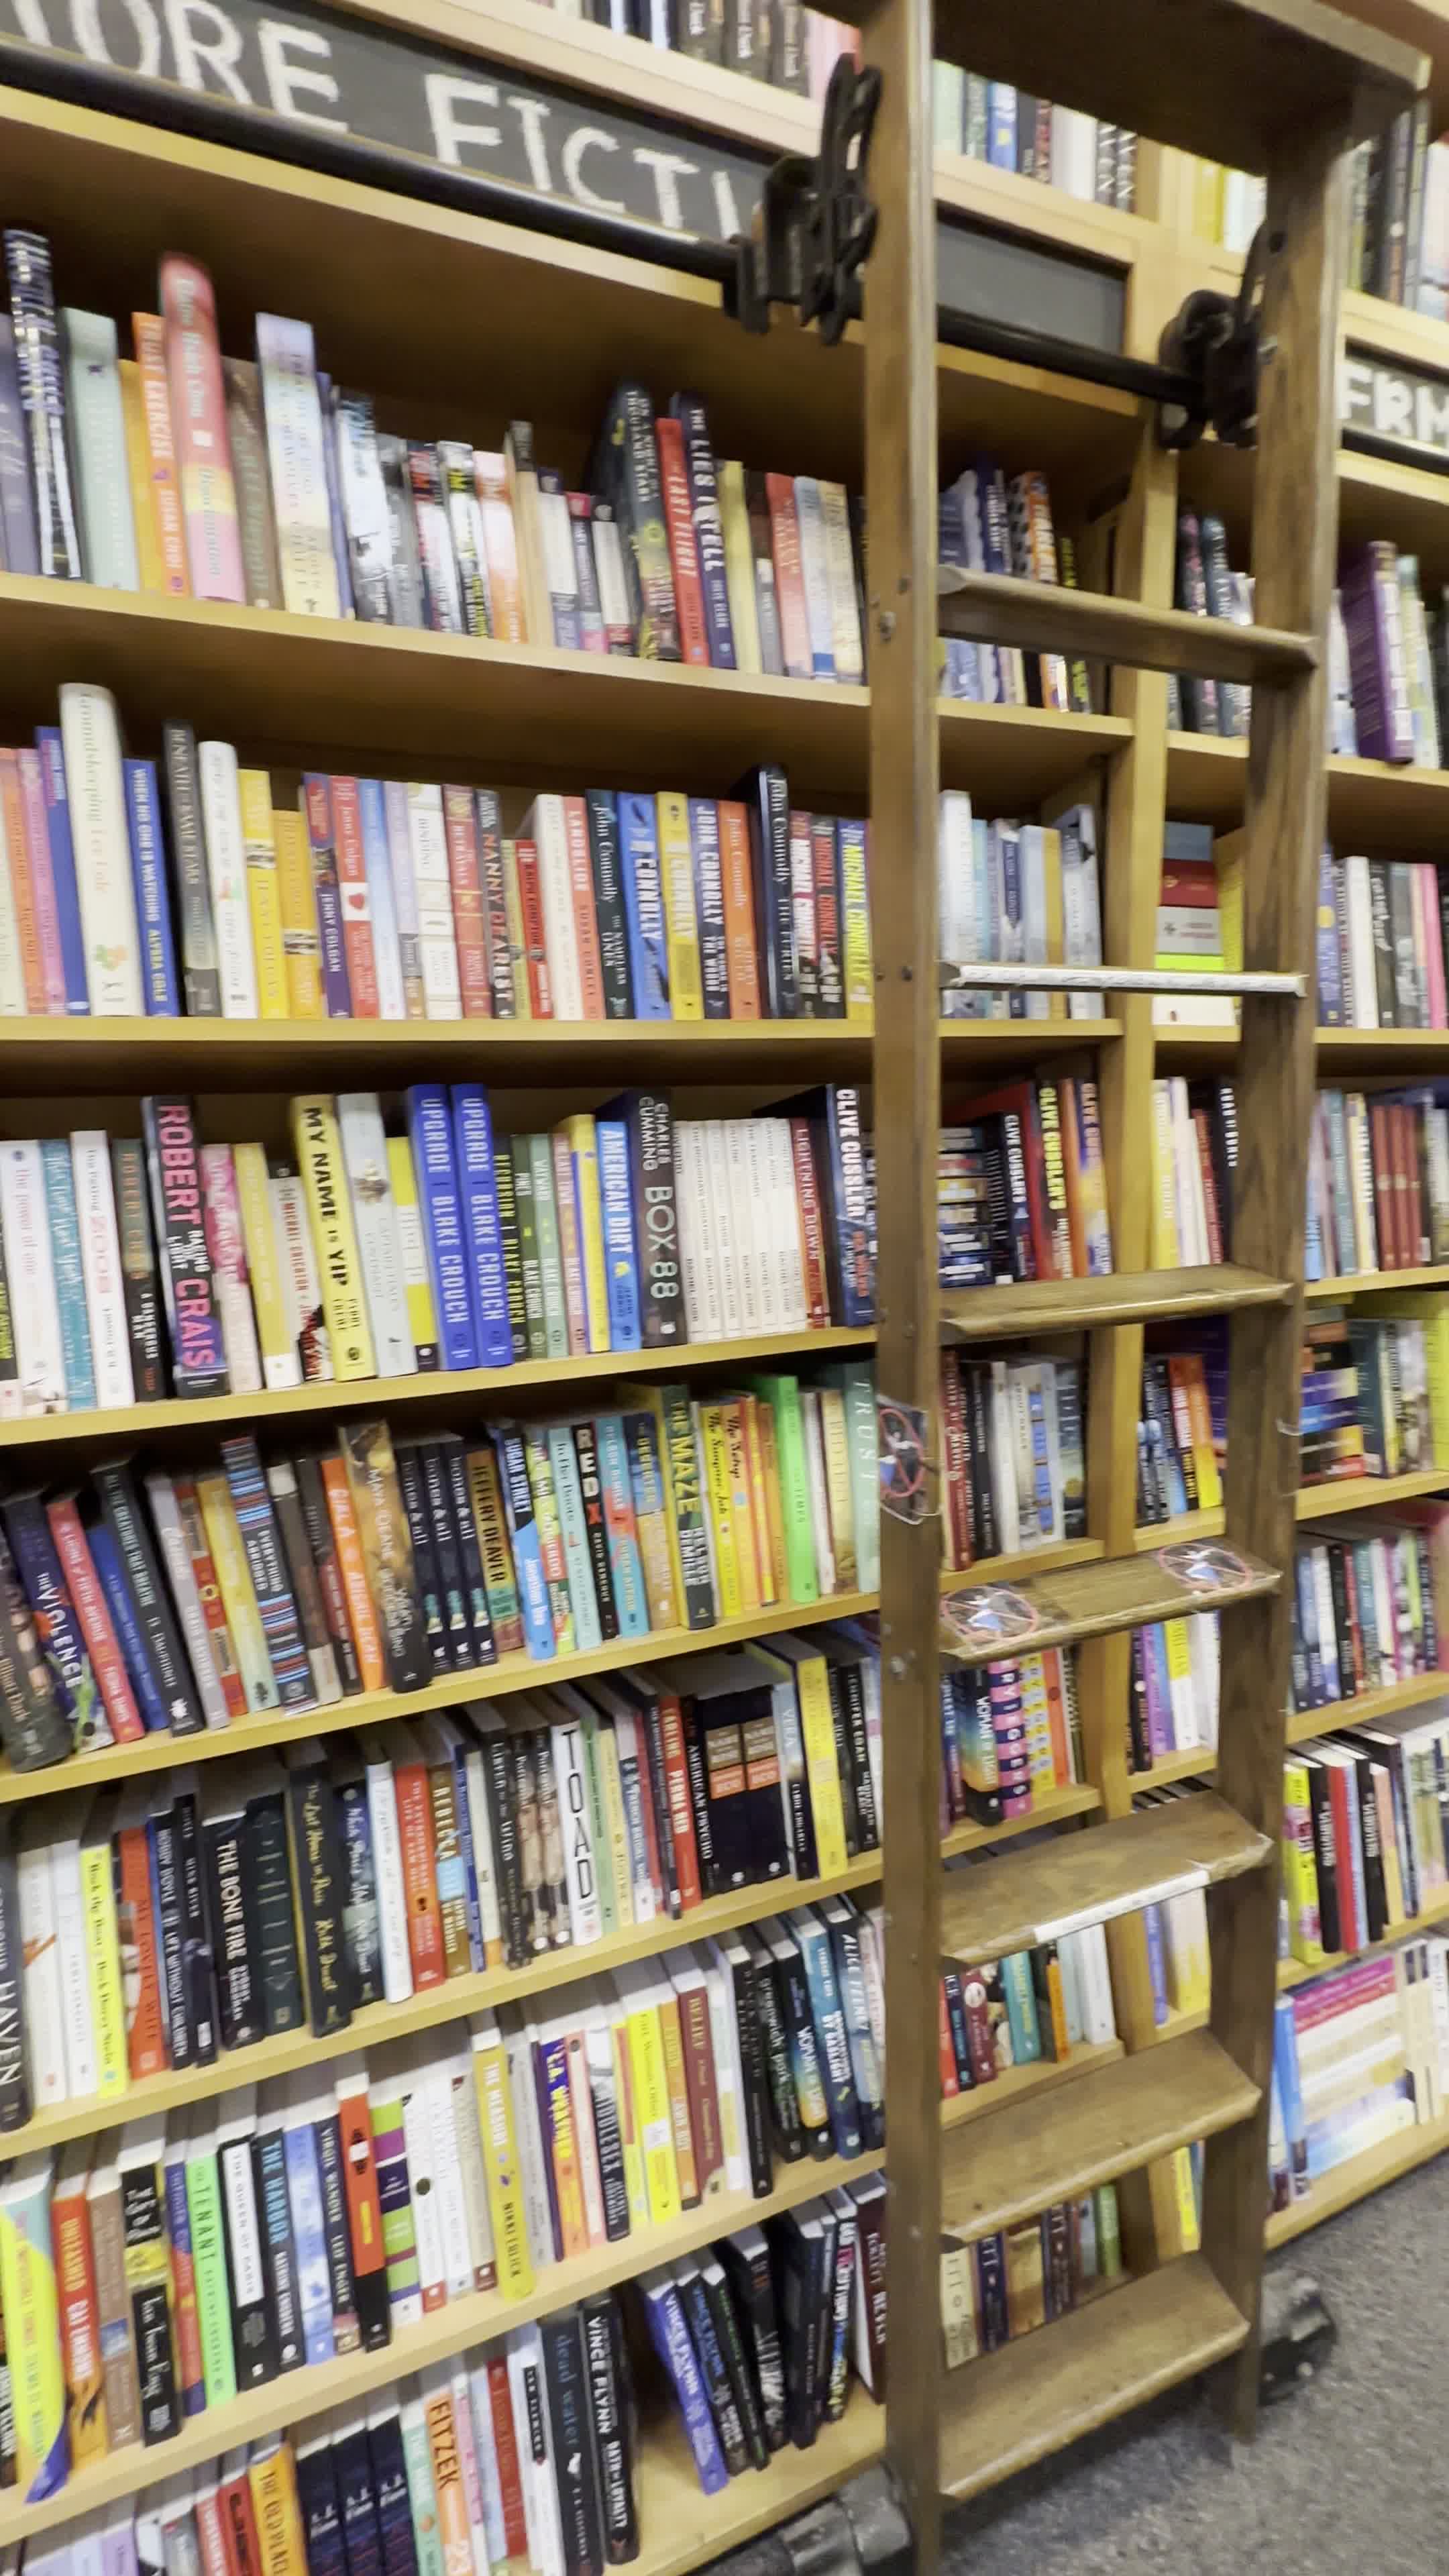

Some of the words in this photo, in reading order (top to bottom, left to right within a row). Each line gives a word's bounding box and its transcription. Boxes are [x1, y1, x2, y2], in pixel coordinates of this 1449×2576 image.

[695, 806, 718, 845] JOHN
[481, 833, 504, 904] NANNY
[698, 851, 723, 924] CONNOLLY
[843, 844, 865, 904] MICHAEL
[303, 1106, 327, 1143] MY
[419, 1097, 451, 1173] UPGRADE
[461, 1097, 490, 1172] UPGRADE
[637, 1096, 659, 1171] CUMMING
[835, 1089, 859, 1138] CLIVE
[154, 1104, 204, 1224] ROBERT
[310, 1152, 339, 1220] NAME
[599, 1130, 632, 1213] AMERICAN
[840, 1140, 866, 1218] CUSSLER
[432, 1195, 460, 1247] BLAKE
[470, 1194, 497, 1245] BLAKE
[606, 1217, 633, 1254] DIRT
[642, 1186, 678, 1252] BOX
[325, 1249, 350, 1287] YIP
[439, 1254, 470, 1323] CROUCH
[476, 1252, 504, 1320] CROUCH
[647, 1261, 680, 1299] 88
[172, 1277, 218, 1367] CRAIS
[574, 1428, 600, 1497] RED
[669, 1434, 702, 1515] MAZE
[560, 1728, 596, 1899] TOAD
[216, 1840, 239, 1870] THE
[217, 1876, 246, 1923] BONE
[223, 1923, 248, 1959] FIRE
[260, 2141, 284, 2173] THE
[587, 2316, 606, 2371] VINCE
[592, 2377, 612, 2434] FLYNN
[427, 2401, 462, 2490] FITZEK
